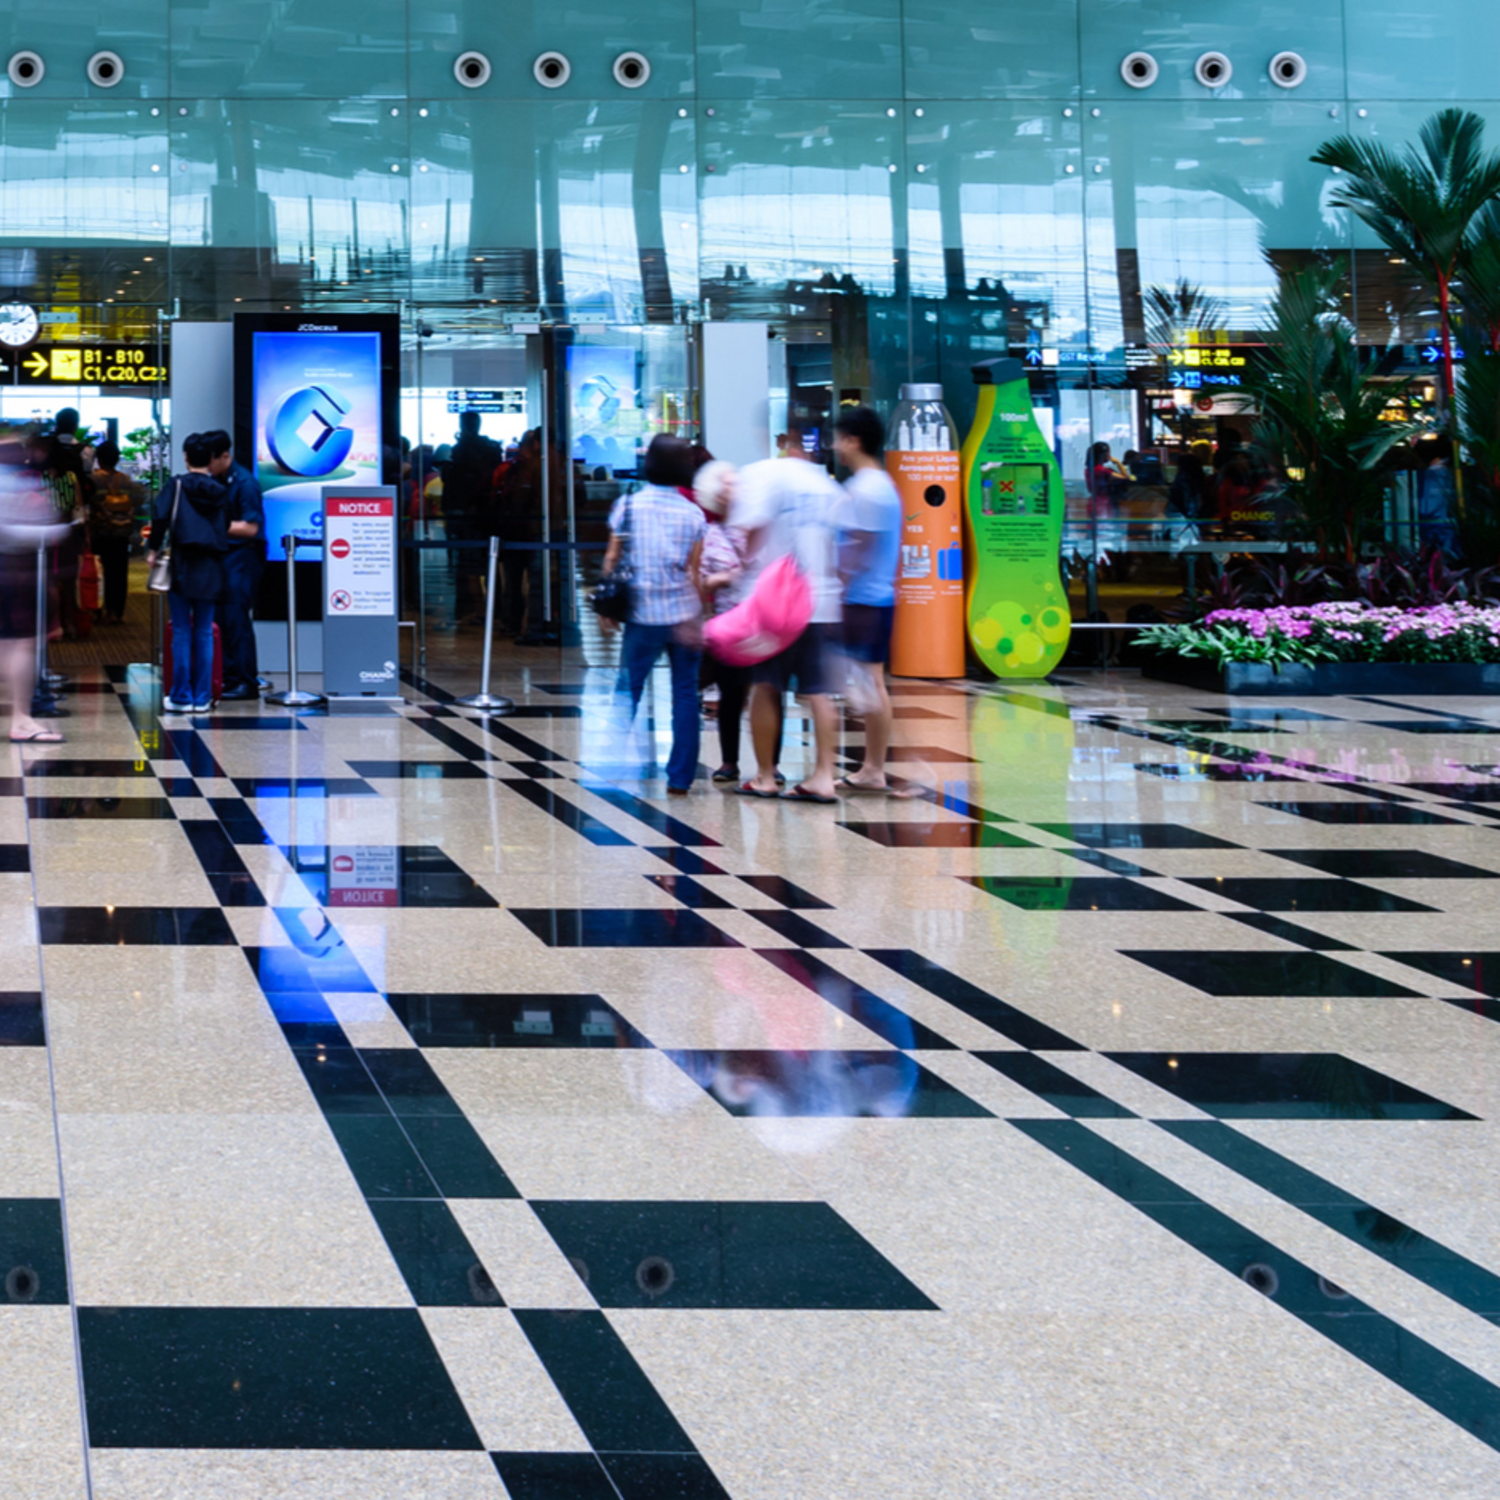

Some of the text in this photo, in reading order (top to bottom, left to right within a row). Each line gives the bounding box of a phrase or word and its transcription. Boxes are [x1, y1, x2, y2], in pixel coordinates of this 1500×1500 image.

[83, 350, 102, 363] B1
[116, 350, 144, 364] B10
[338, 503, 381, 514] NOTICE
[906, 525, 923, 533] YES
